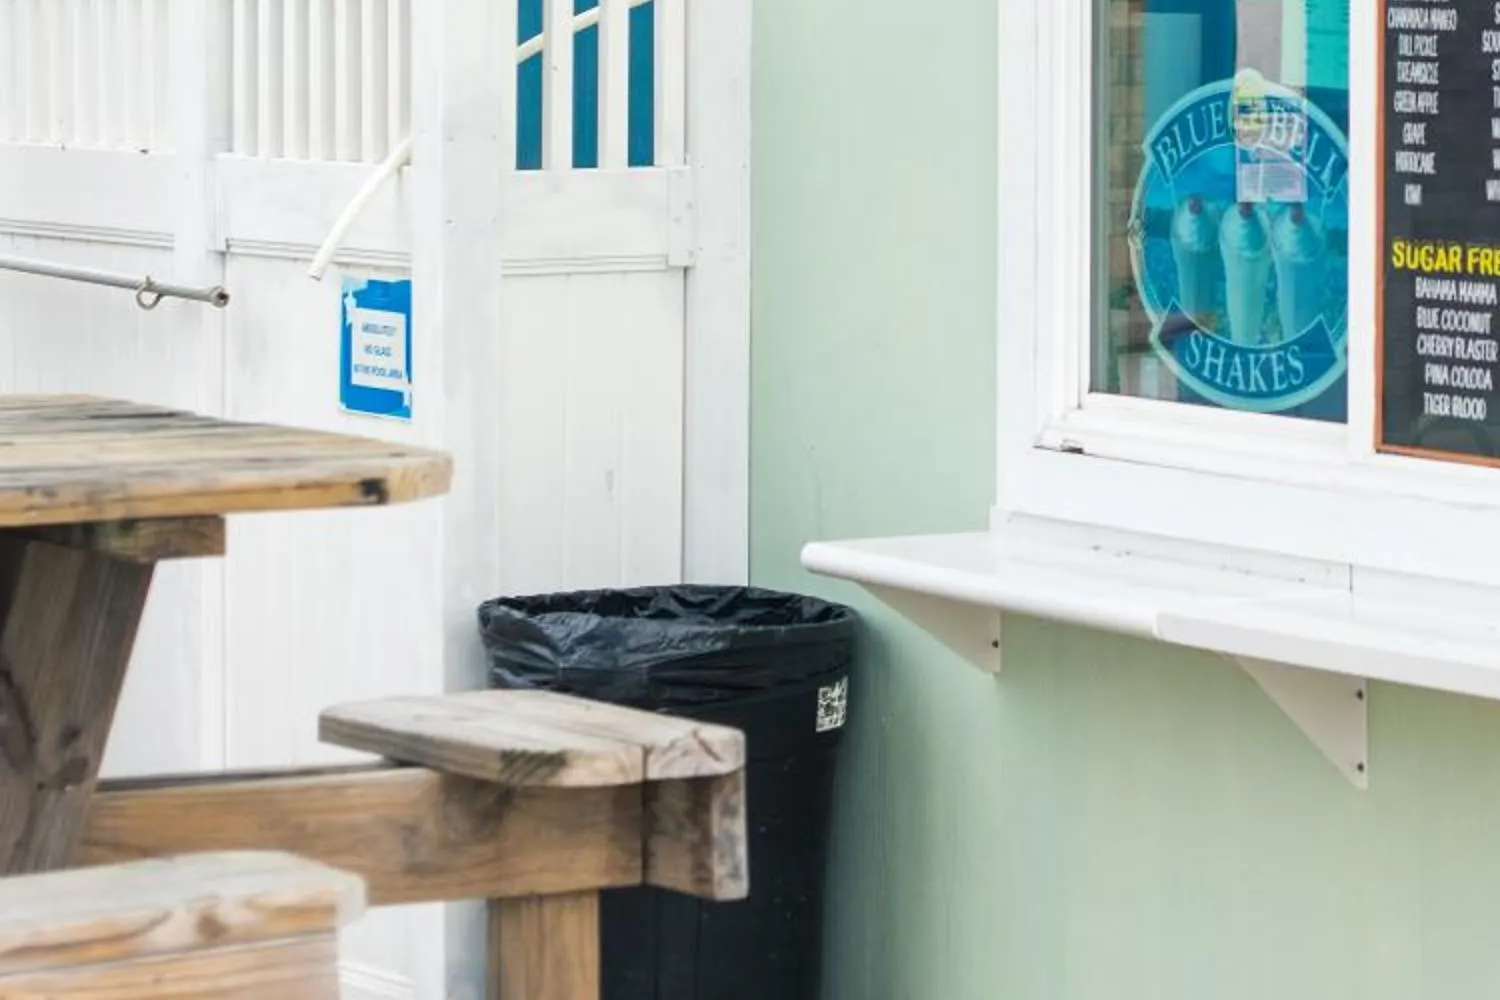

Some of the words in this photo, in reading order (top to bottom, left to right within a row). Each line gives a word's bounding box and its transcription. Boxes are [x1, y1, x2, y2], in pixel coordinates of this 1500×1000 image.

[1155, 99, 1225, 170] BLUE
[1402, 121, 1427, 145] GRAPE
[1391, 238, 1462, 274] SUGAR
[1415, 276, 1457, 302] BAHAMA
[1416, 305, 1440, 329] BLUE
[1440, 308, 1492, 335] COCONUT
[1185, 332, 1305, 393] SHAKES
[1417, 333, 1454, 357] CHERRY
[1455, 336, 1499, 362] BLASTER
[1425, 362, 1449, 386] PINA
[1423, 391, 1451, 417] TIGER
[1452, 395, 1488, 421] BLOOD
